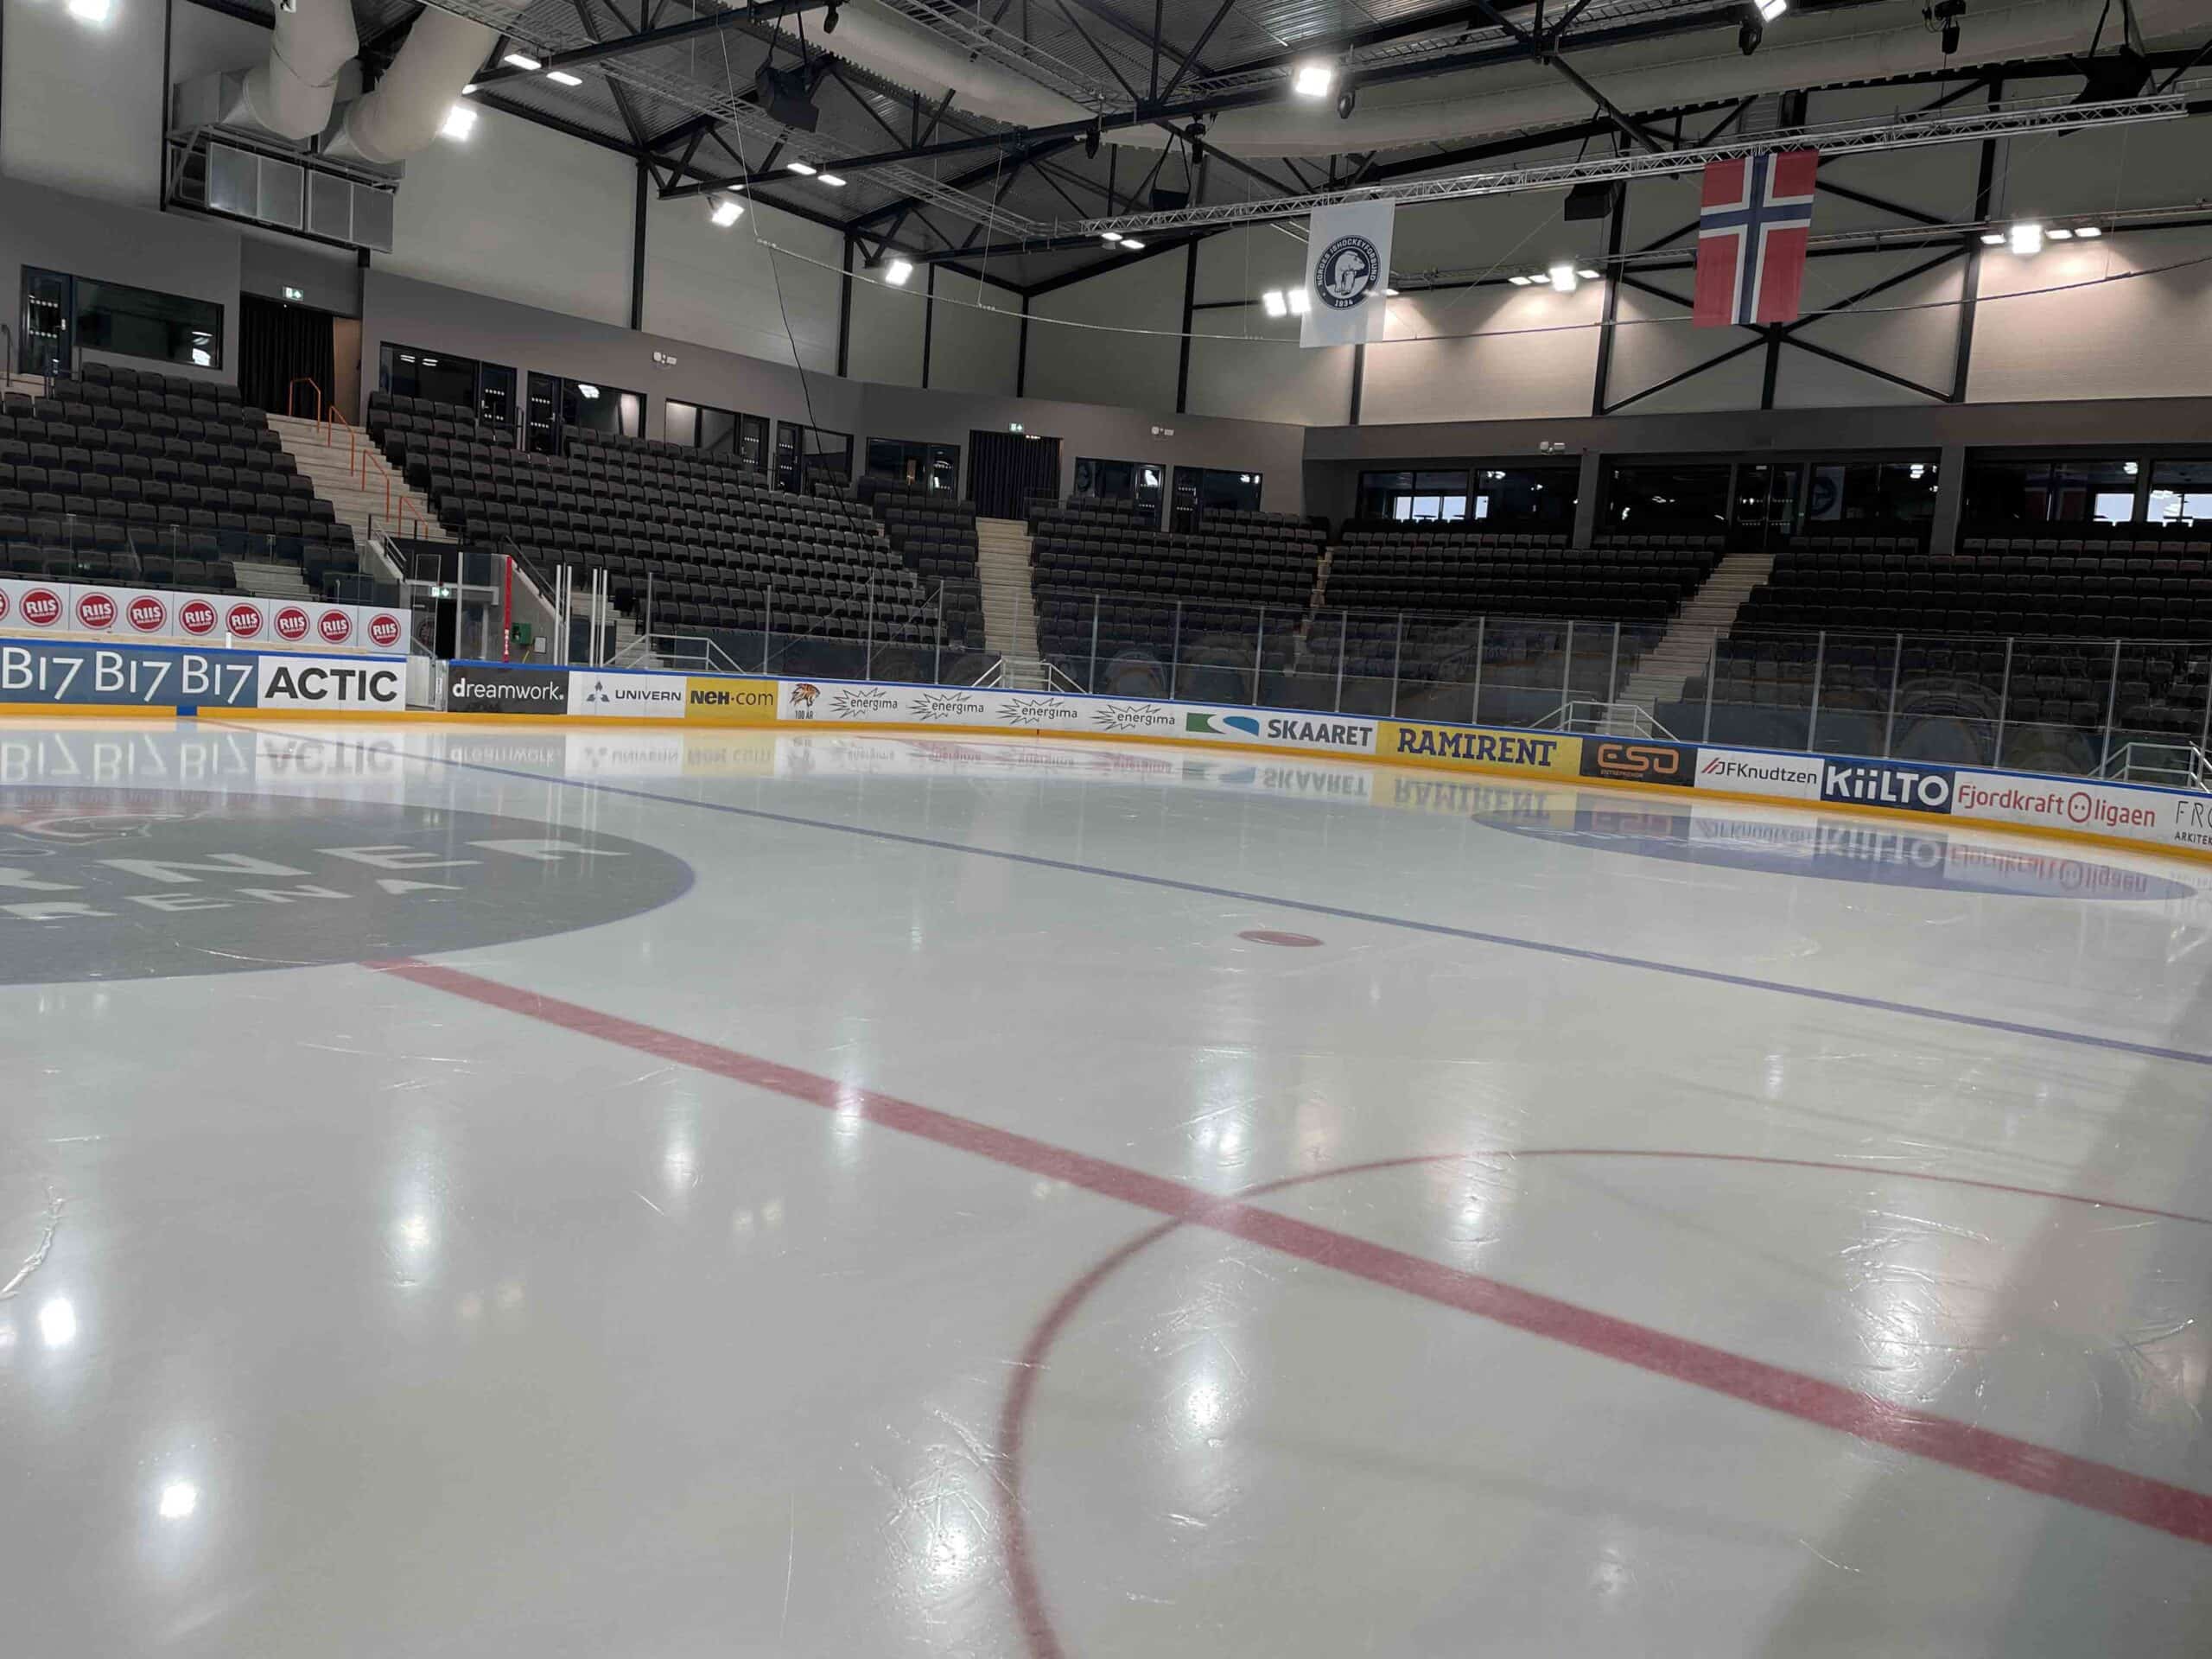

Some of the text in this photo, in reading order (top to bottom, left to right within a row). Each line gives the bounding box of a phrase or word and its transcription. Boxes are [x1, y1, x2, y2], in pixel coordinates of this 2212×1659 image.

[1316, 238, 1377, 286] NORGES ISHOCKEYFORBUND
[1335, 299, 1354, 308] 1934
[26, 598, 57, 614] RIIS
[82, 603, 112, 618] RIIS
[132, 606, 162, 620] RIIS
[184, 608, 213, 624] RIIS
[231, 613, 258, 627] RIIS
[279, 616, 305, 631] RIIS
[322, 619, 347, 633] RIIS
[372, 623, 397, 637] RIIS
[264, 666, 397, 702] ACTIC
[615, 690, 682, 702] UNIVERN
[850, 696, 899, 711] energima
[931, 700, 985, 715] energima
[1021, 705, 1078, 721] energima
[1116, 711, 1177, 727] energima
[1267, 718, 1373, 747] SKAARET
[1396, 727, 1557, 767] RAMIRENT
[1957, 785, 2156, 828] Fjordkraft ligaen
